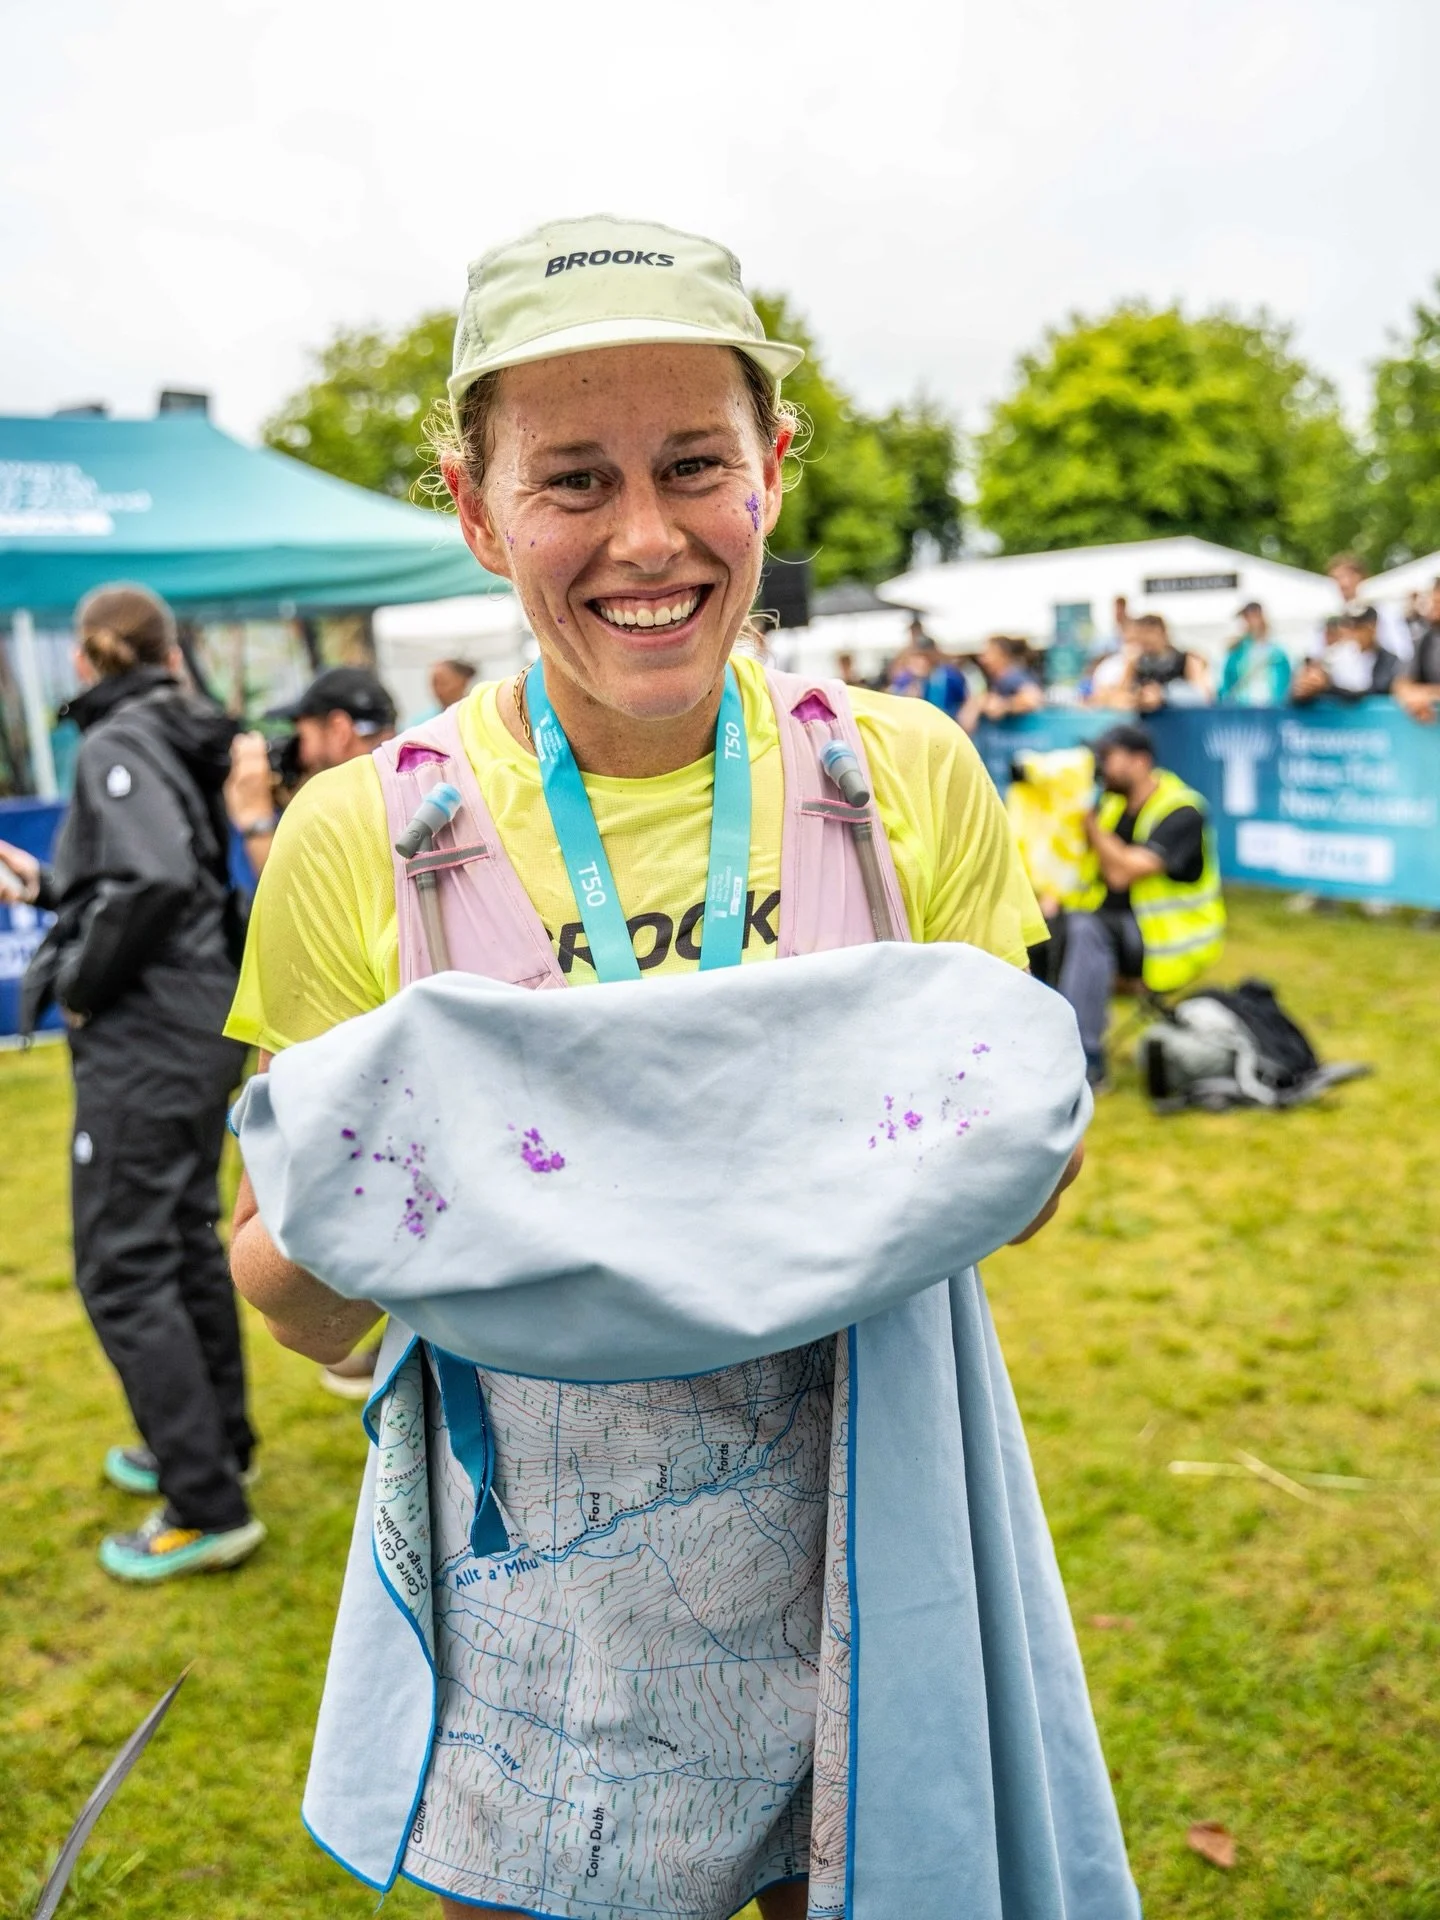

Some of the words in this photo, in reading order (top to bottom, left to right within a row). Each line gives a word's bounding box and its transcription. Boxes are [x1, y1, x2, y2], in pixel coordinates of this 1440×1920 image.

[545, 249, 675, 278] BROOKS
[725, 722, 741, 760] T50
[578, 861, 607, 907] T50
[545, 889, 781, 974] ROOK
[717, 1443, 729, 1471] Fords
[656, 1463, 667, 1490] Ford
[588, 1492, 600, 1522] Ford
[379, 1505, 408, 1551] Duibhe
[396, 1561, 420, 1596] Coire
[406, 1550, 429, 1590] Creige
[455, 1568, 482, 1590] Allt
[448, 1730, 484, 1745] Choire
[648, 1735, 678, 1752] Posts
[589, 1806, 605, 1841] Dubh
[585, 1844, 601, 1879] Coire
